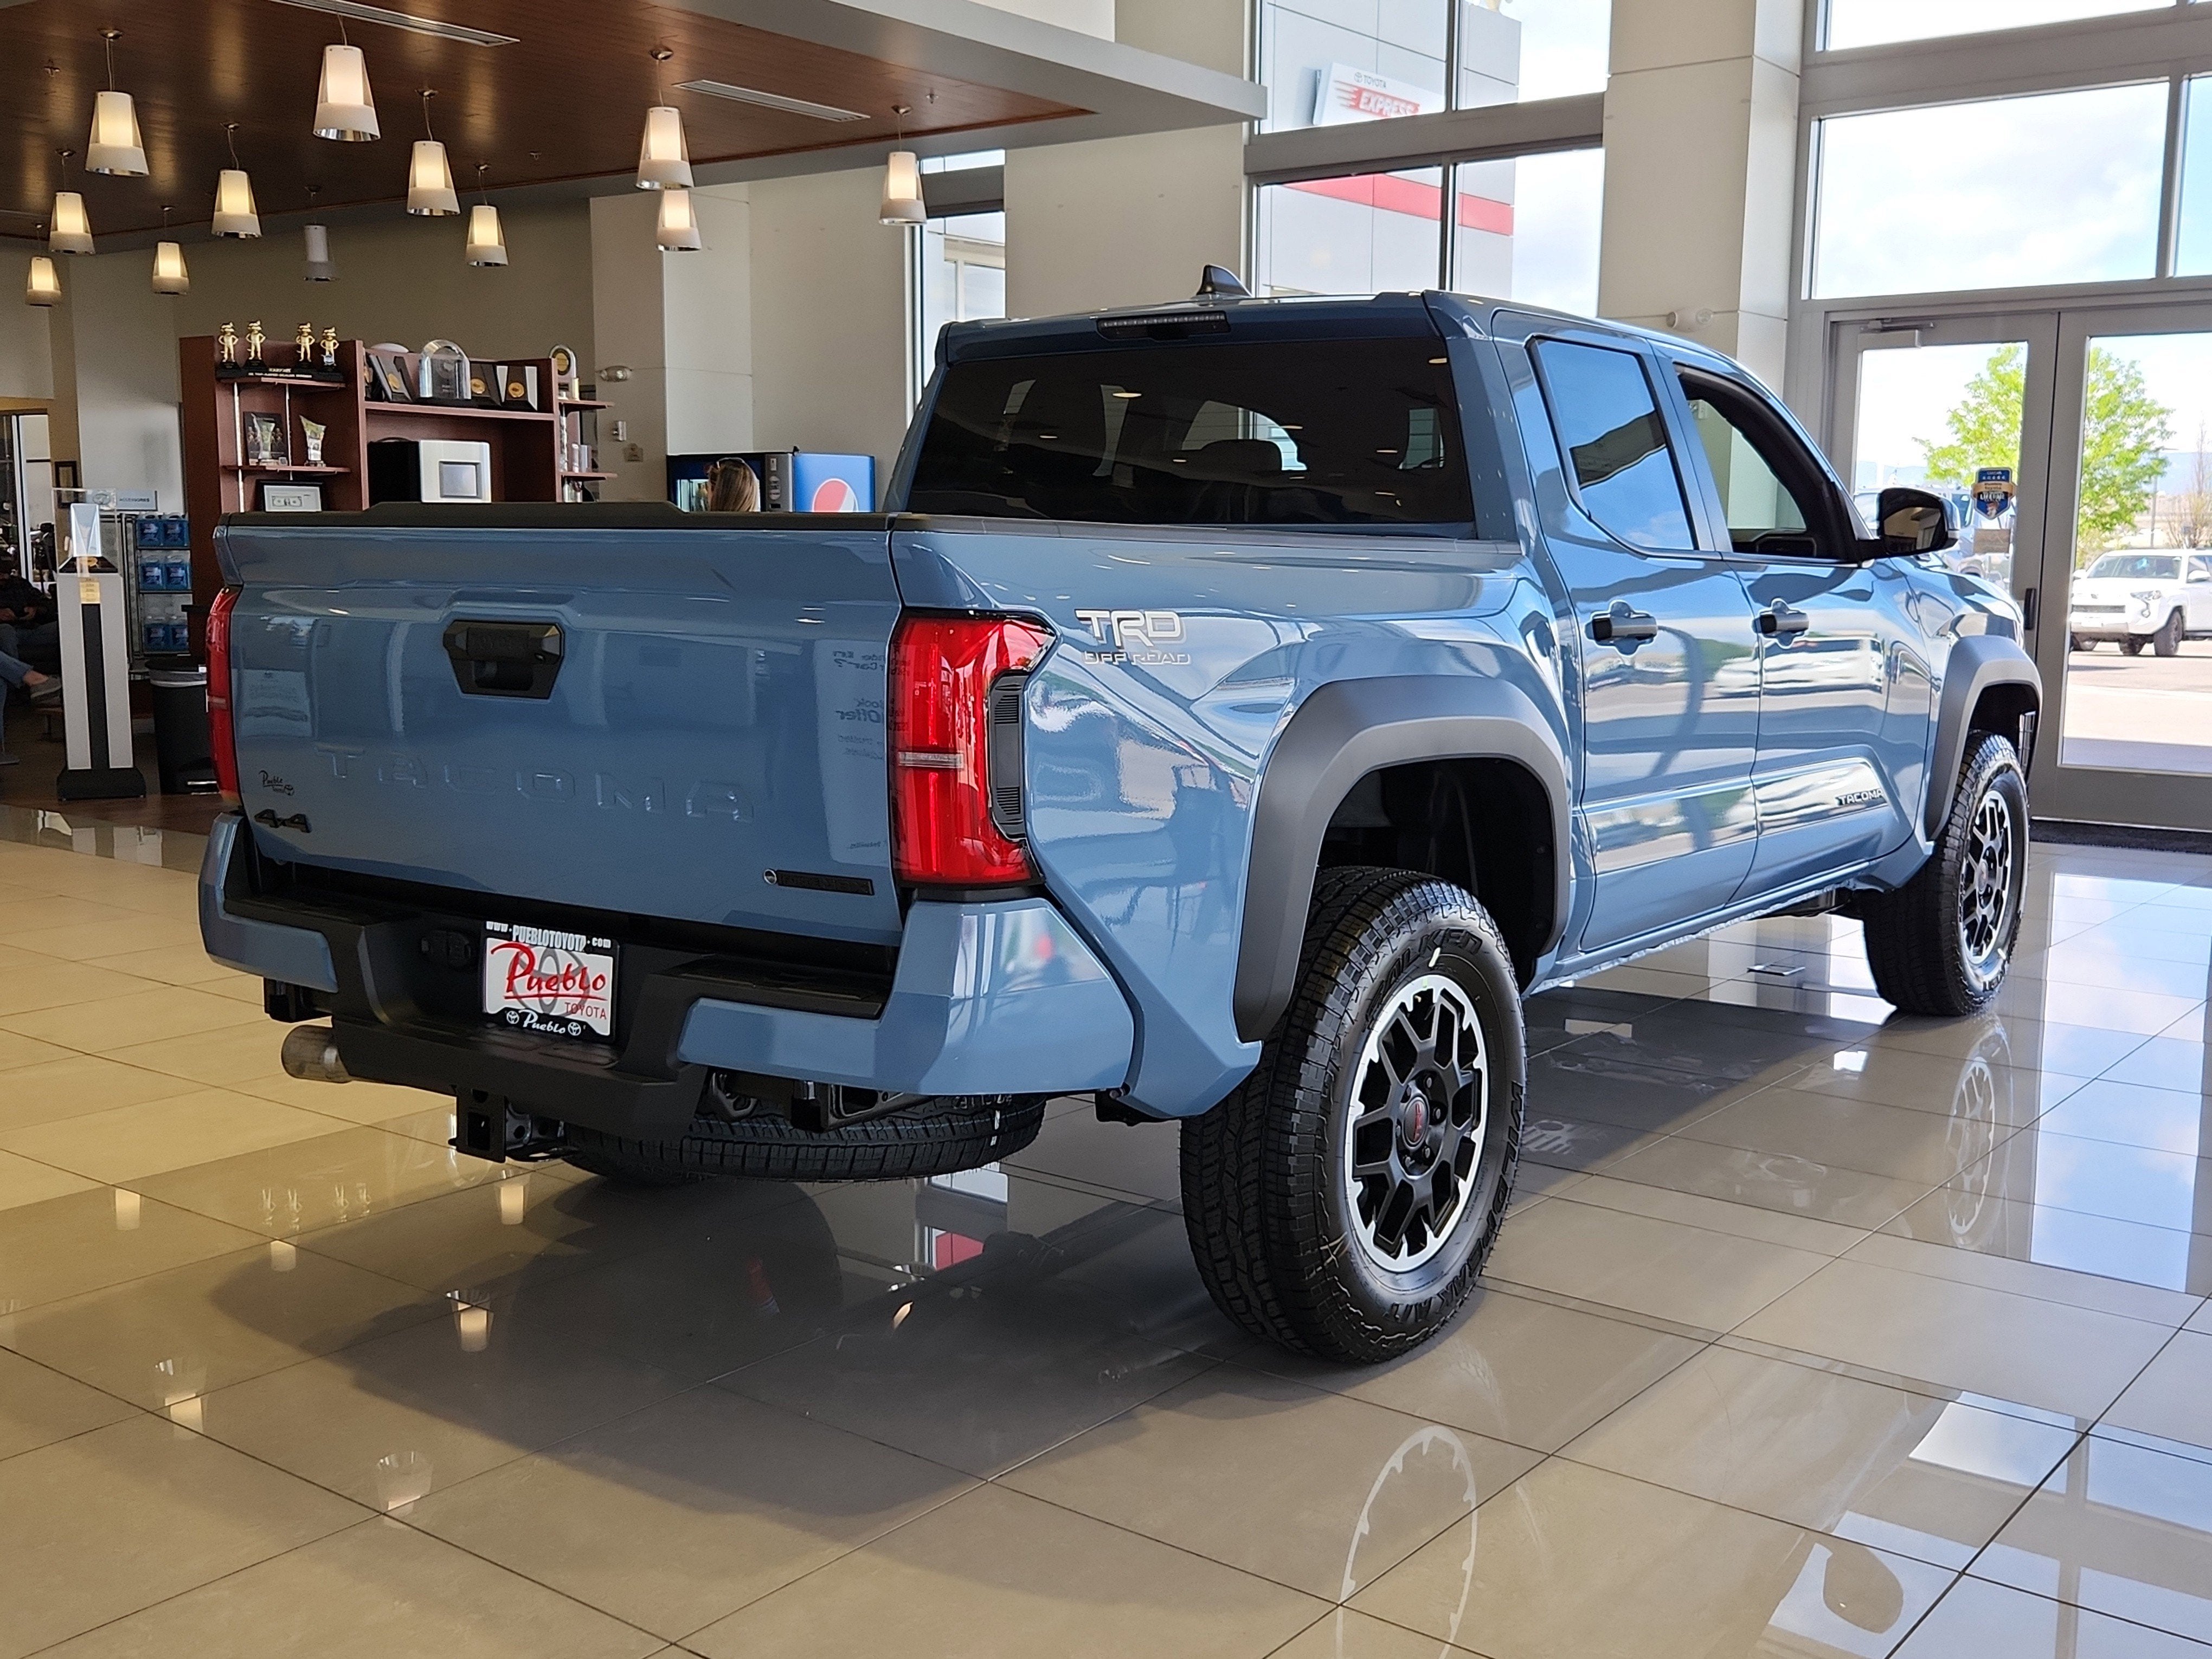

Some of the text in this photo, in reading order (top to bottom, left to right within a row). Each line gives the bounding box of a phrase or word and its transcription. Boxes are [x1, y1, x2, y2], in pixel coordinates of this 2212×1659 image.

[1363, 74, 1386, 88] TOYOTA
[1360, 92, 1413, 118] EXPRESS
[1075, 610, 1181, 647] TRD
[1084, 651, 1191, 665] OFF ROAD
[313, 741, 755, 823] TACOMA
[1838, 788, 1884, 805] TACOMA
[490, 942, 606, 993] Pueblo
[518, 1009, 566, 1034] Pueblo
[564, 1002, 607, 1020] TOYOTA
